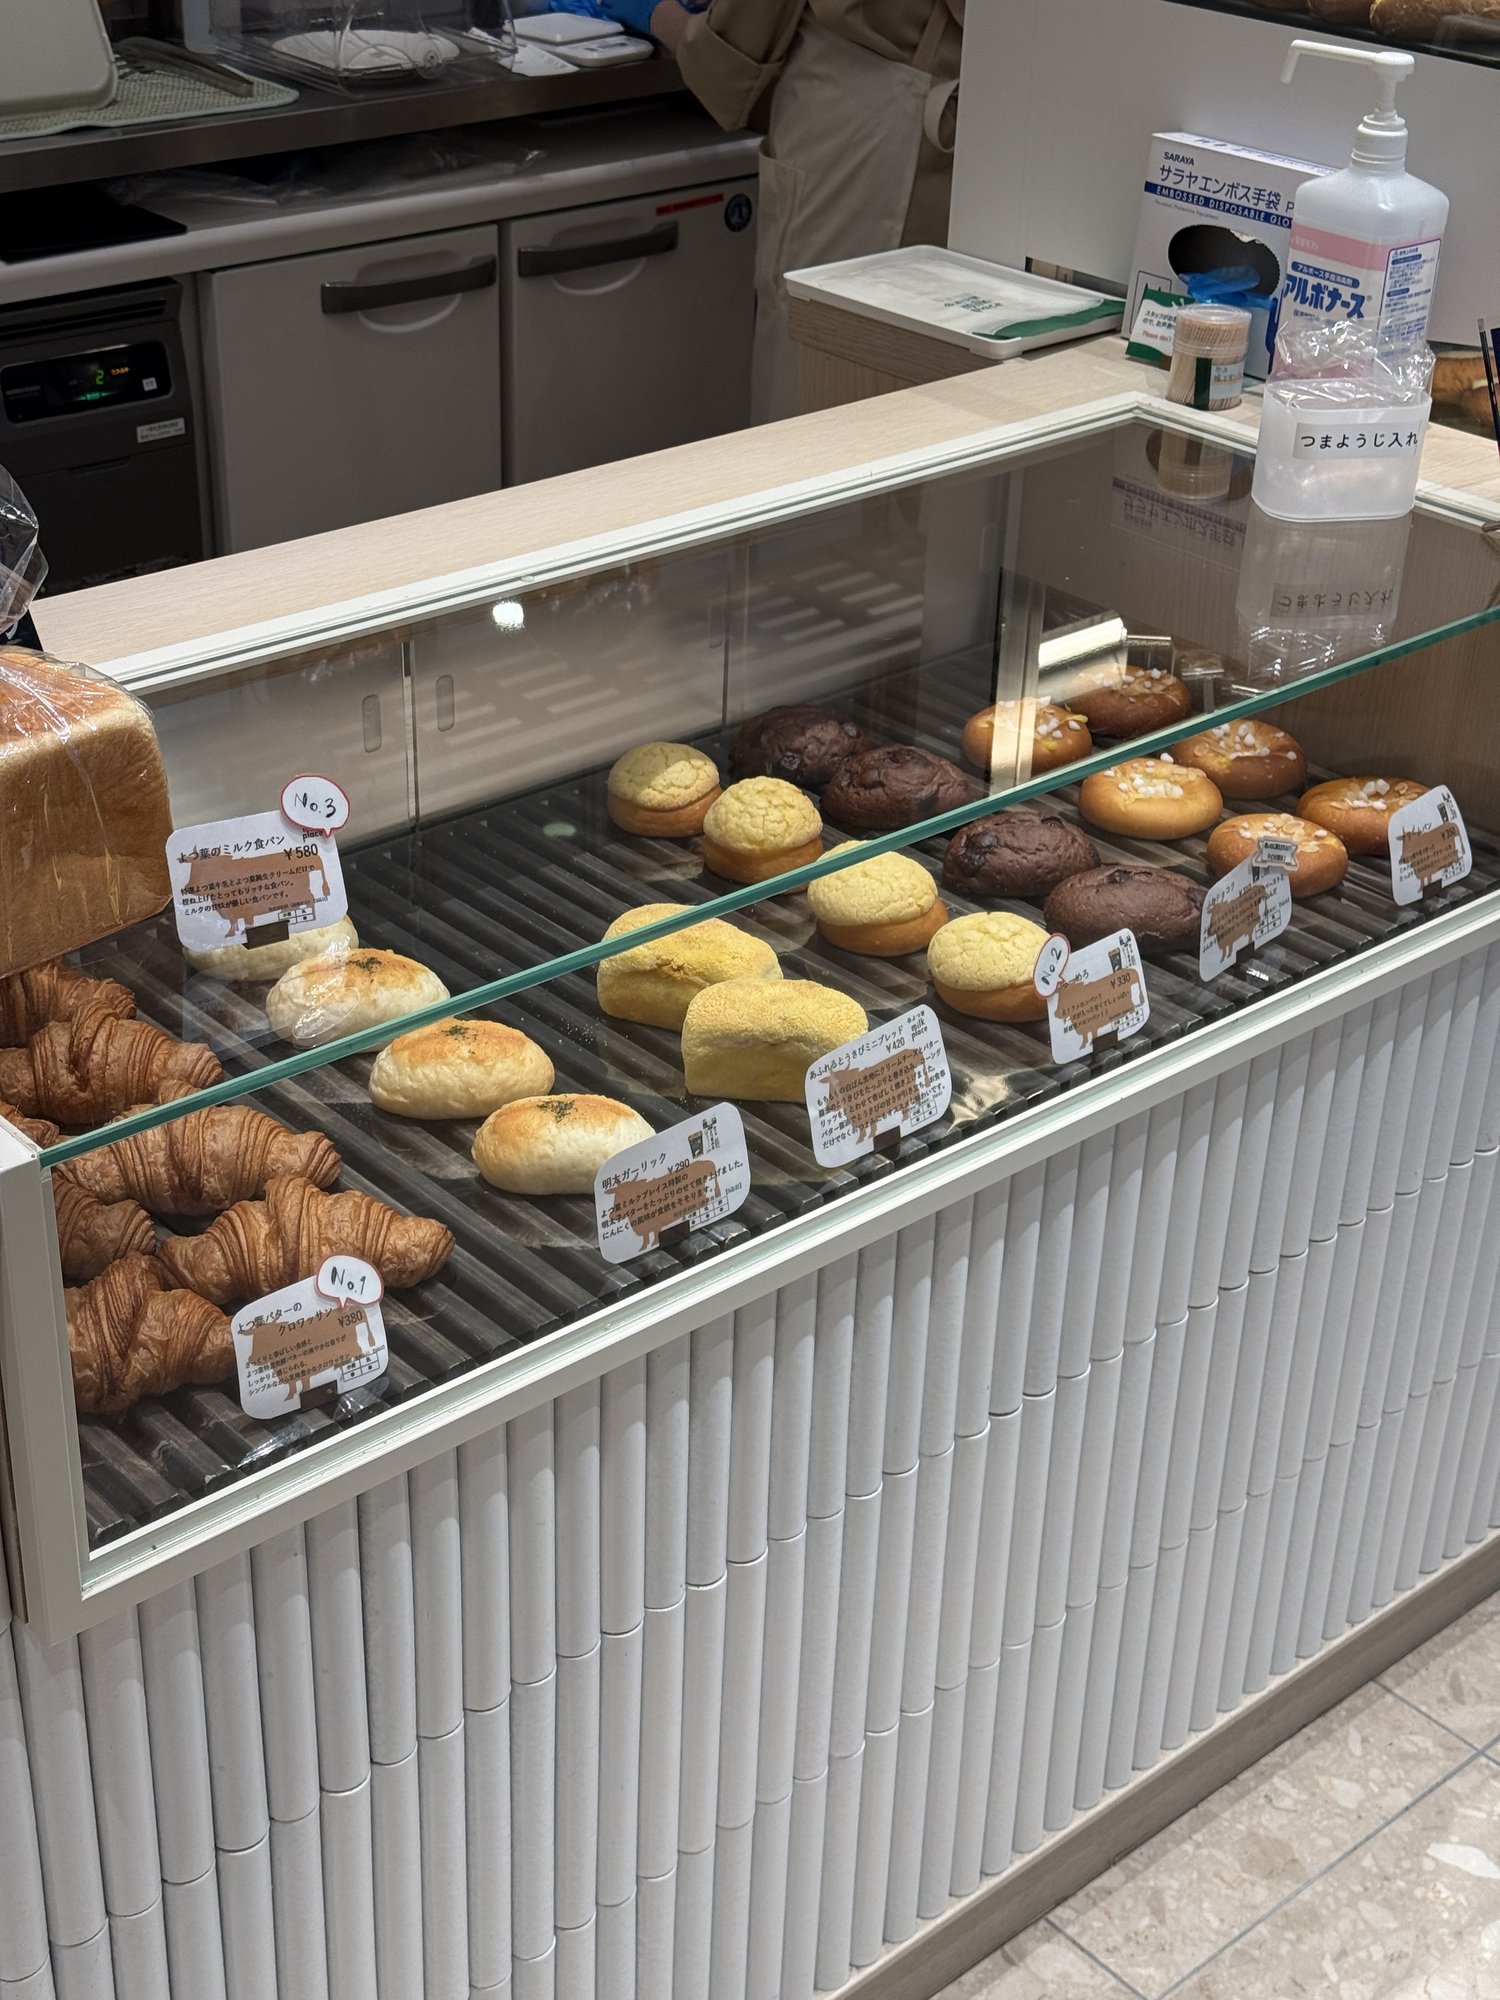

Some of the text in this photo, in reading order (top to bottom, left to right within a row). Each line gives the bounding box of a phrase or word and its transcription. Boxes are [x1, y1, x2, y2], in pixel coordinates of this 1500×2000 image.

[1163, 151, 1195, 166] SARAYA
[1159, 164, 1282, 212] サラヤエンボス手袋
[1156, 186, 1293, 229] EMBOSSED DISPOSABLE GLO
[1283, 273, 1366, 319] アルボナース
[1301, 431, 1419, 450] つまようじ入れ
[294, 792, 337, 818] No.3
[177, 834, 286, 864] よつ葉のミルク食パン
[283, 843, 319, 861] ¥580
[911, 1017, 926, 1032] milk
[911, 1026, 928, 1042] place
[809, 1025, 904, 1081] あふれるとうきびミニブレッド
[885, 1037, 906, 1053] ¥420
[602, 1152, 667, 1190] 明太ガーリック
[667, 1158, 690, 1175] ¥290
[330, 1266, 367, 1295] No.1
[278, 1306, 333, 1337] クロワッサン
[338, 1310, 363, 1329] ¥380
